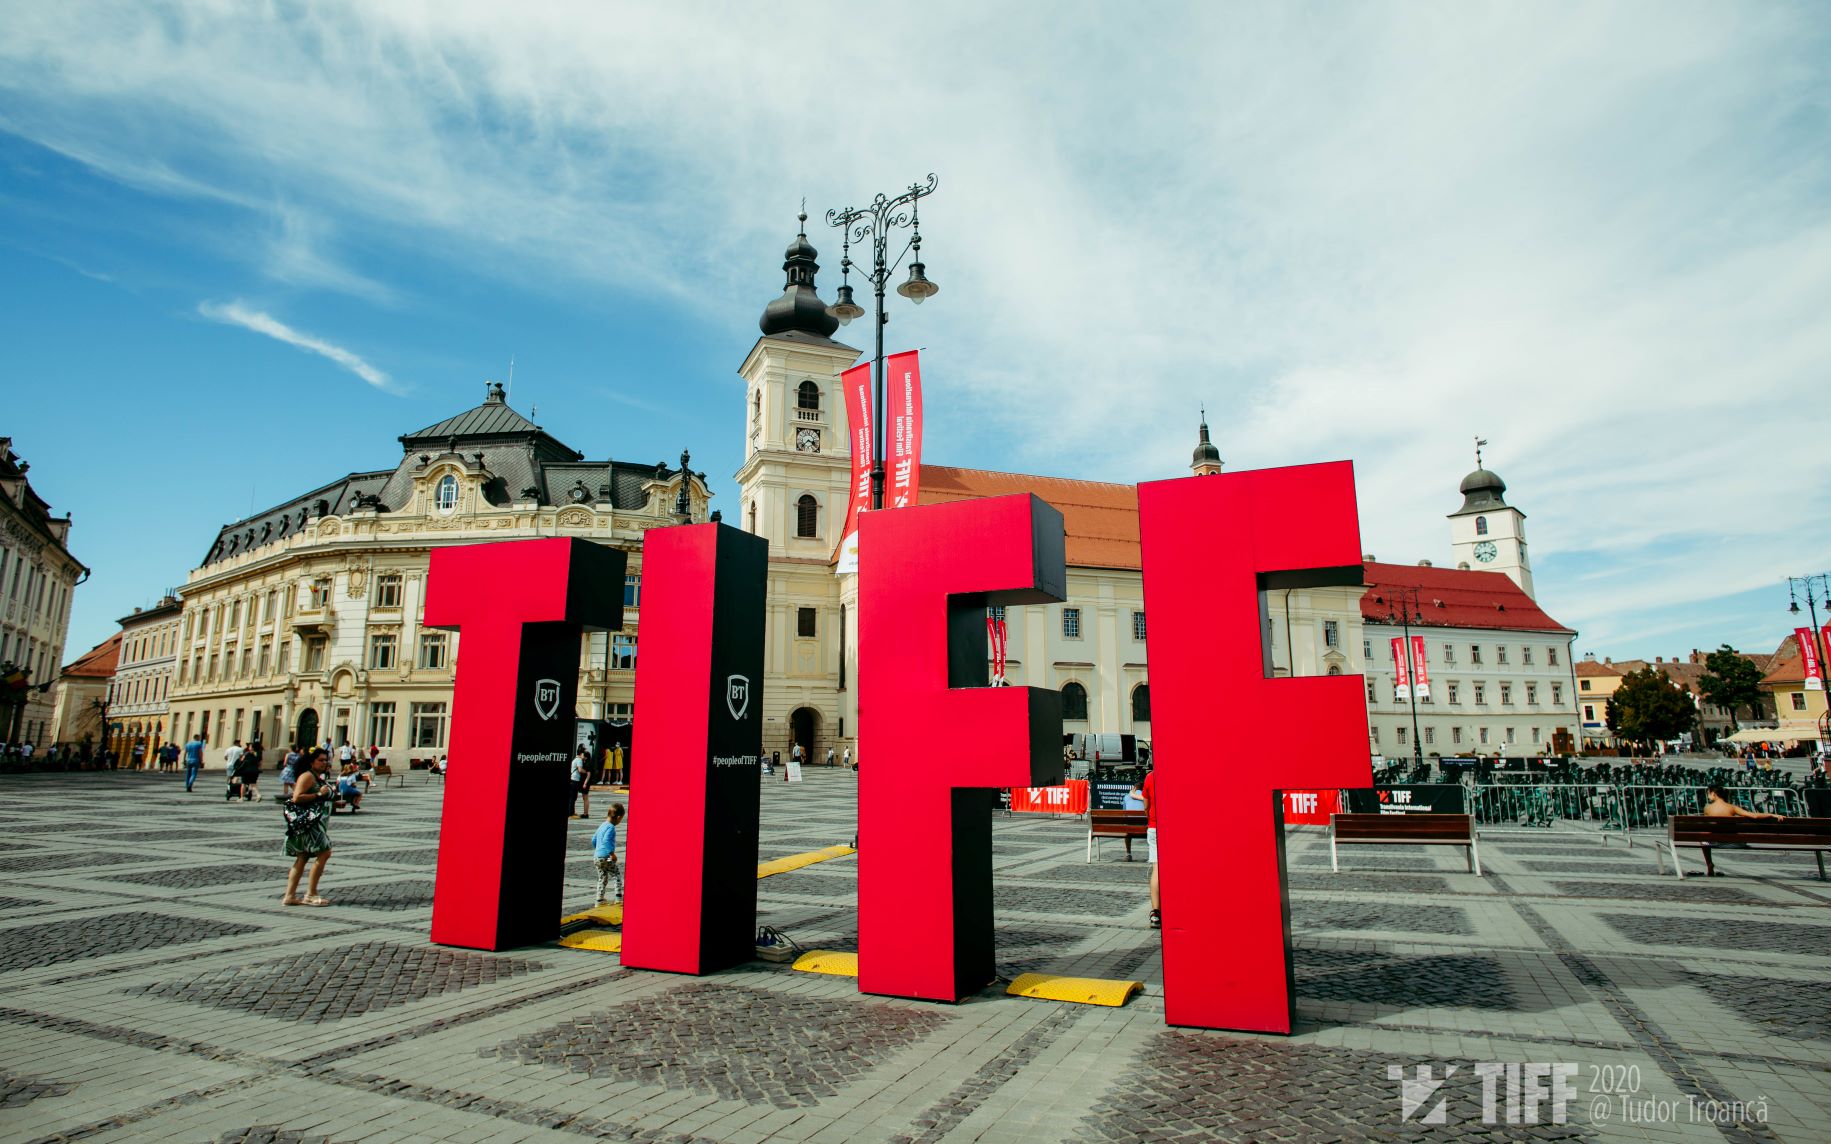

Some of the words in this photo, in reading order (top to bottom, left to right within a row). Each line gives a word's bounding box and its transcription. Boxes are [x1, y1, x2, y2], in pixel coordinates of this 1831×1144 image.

[540, 688, 556, 702] BT
[731, 685, 745, 700] BT
[517, 752, 568, 763] #peopleofTIFF
[712, 755, 757, 767] #peopleofTIFF
[1046, 788, 1070, 805] TIFF
[1290, 793, 1317, 814] TIFF
[1391, 790, 1412, 803] TIFF
